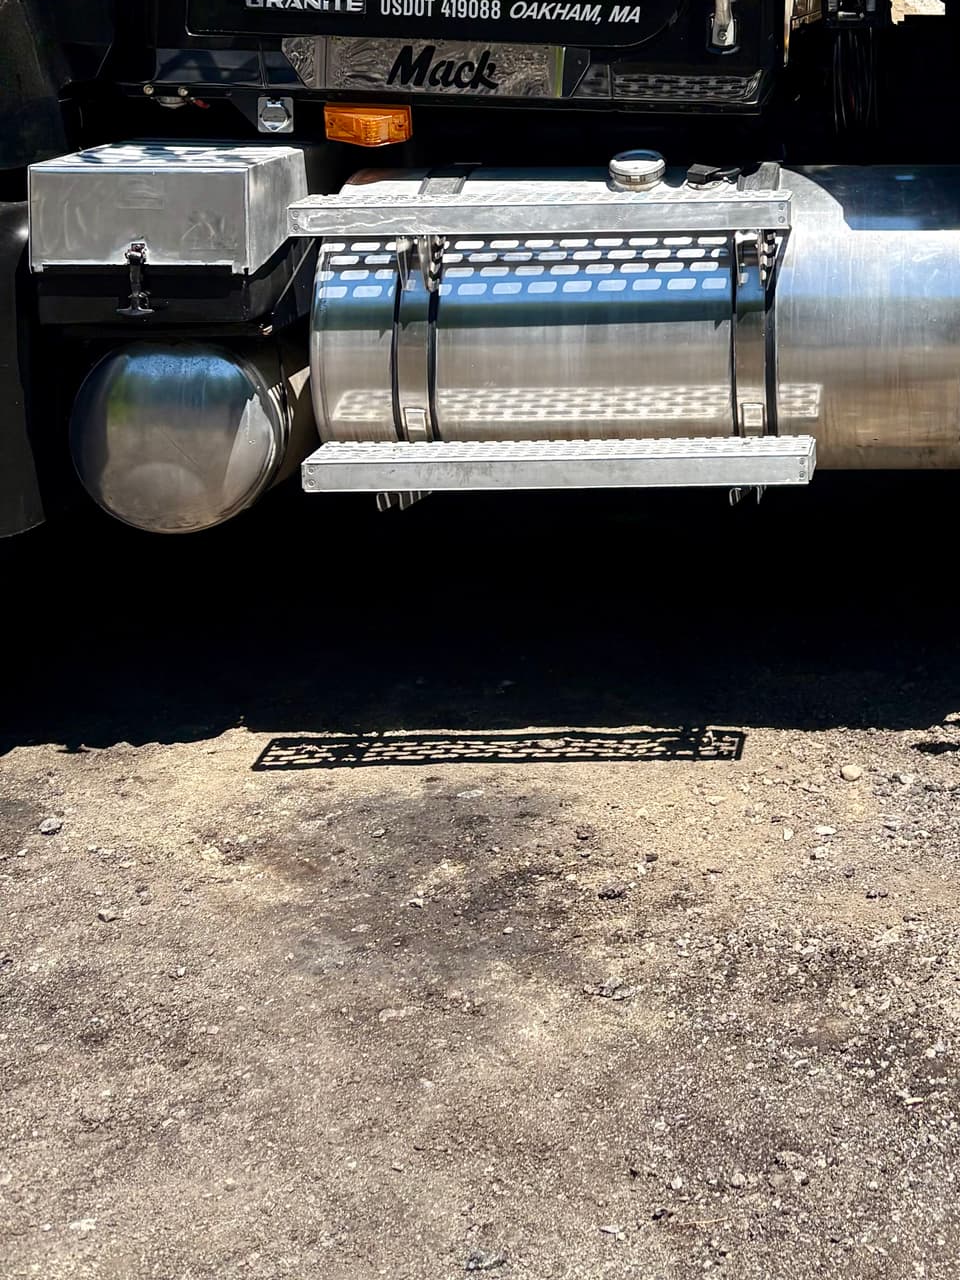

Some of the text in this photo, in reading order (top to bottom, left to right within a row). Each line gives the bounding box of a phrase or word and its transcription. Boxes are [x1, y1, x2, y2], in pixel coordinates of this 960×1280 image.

[509, 0, 602, 25] OAKHAM,
[608, 5, 641, 24] MA
[386, 45, 499, 90] Mack
